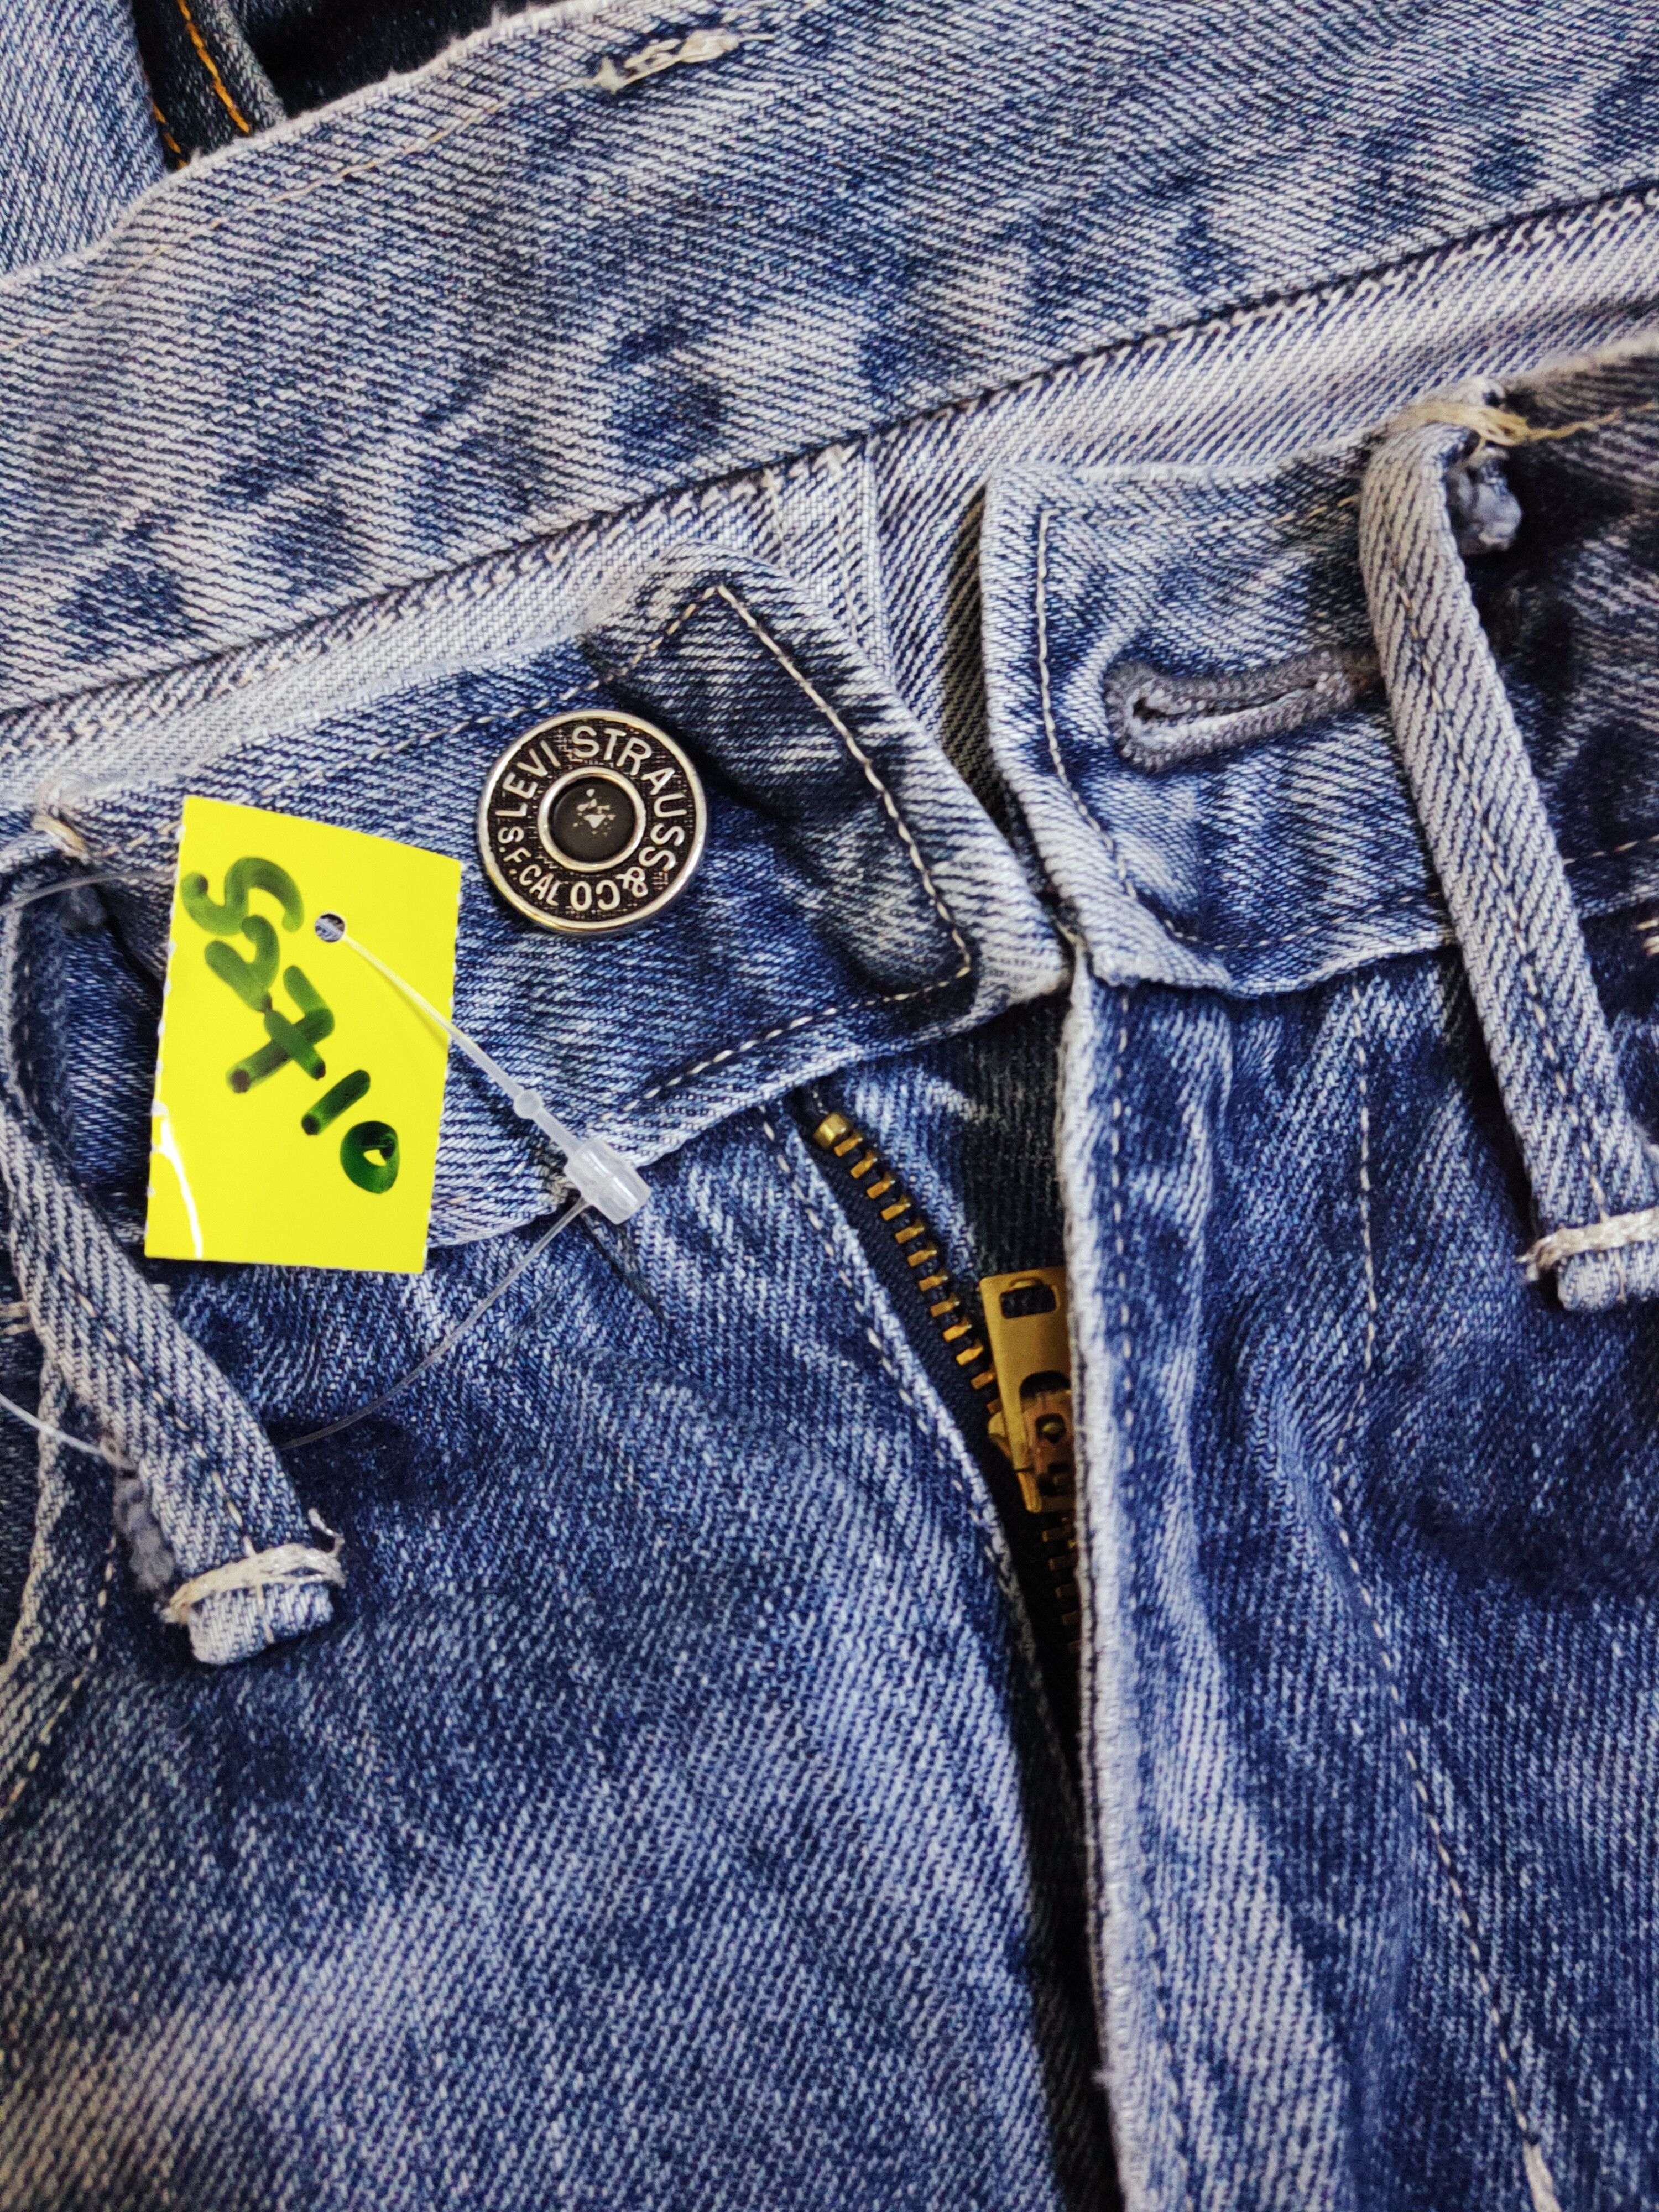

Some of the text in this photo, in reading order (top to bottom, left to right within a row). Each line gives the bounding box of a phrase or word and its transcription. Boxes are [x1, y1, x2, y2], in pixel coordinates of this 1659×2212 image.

[495, 740, 561, 818] LEVI
[571, 725, 687, 872] STRAUSS
[570, 879, 621, 912] CO
